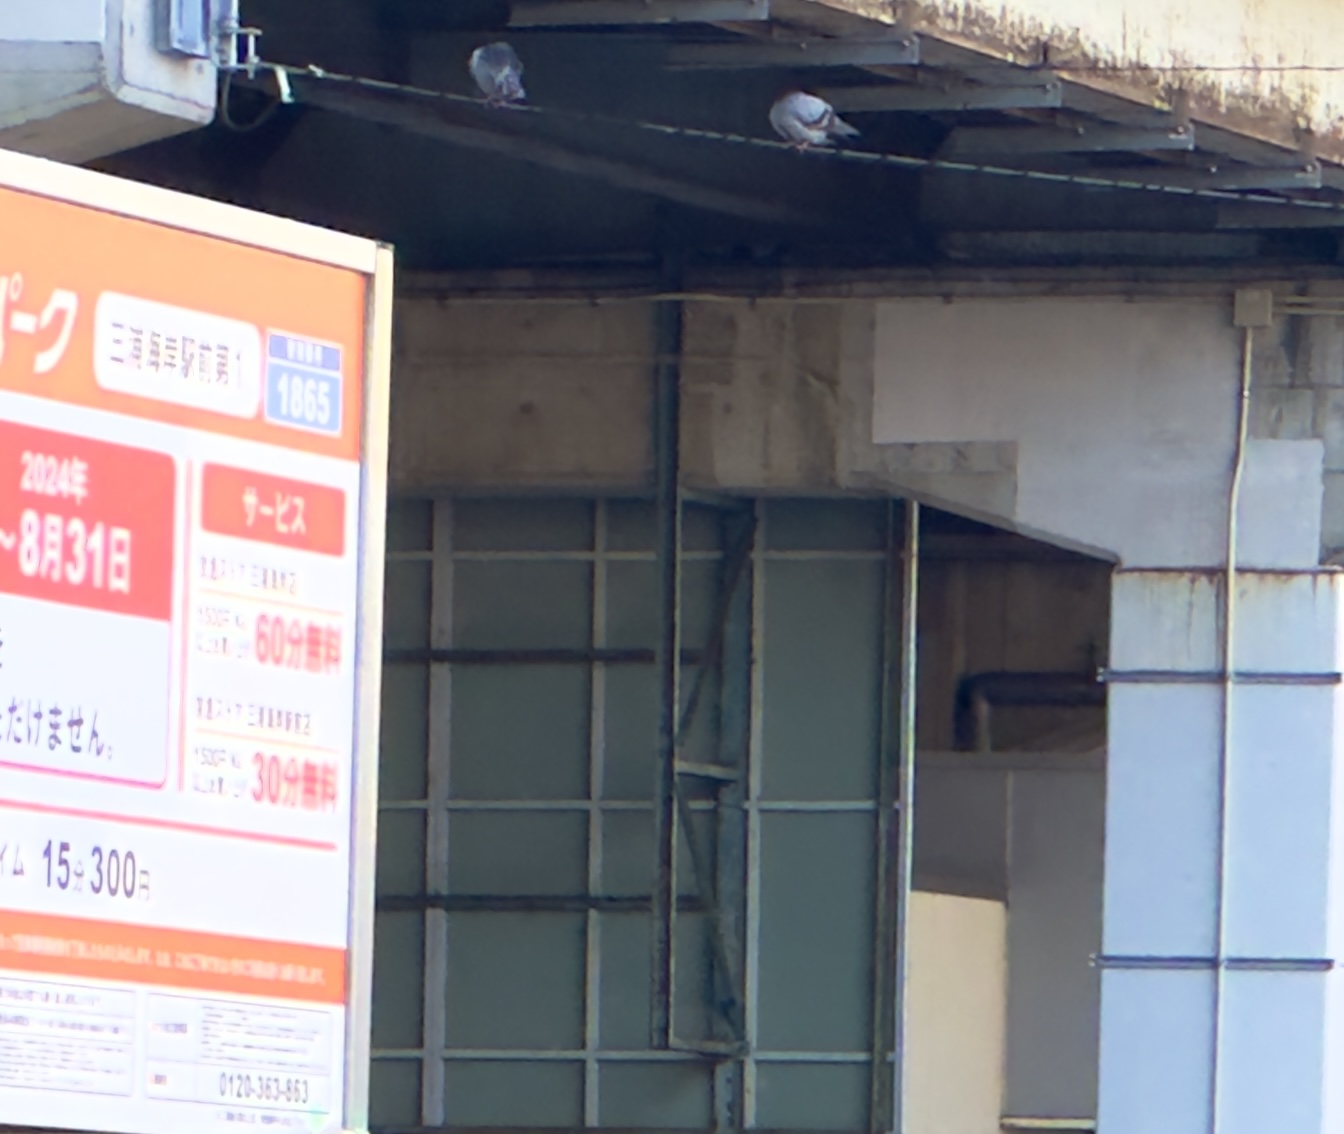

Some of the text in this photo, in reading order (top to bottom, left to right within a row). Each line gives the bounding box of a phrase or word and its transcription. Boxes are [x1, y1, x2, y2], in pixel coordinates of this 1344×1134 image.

[277, 372, 331, 425] 1865
[19, 450, 88, 504] 2024年
[243, 486, 307, 535] サービス
[255, 611, 342, 674] 60分無料
[0, 697, 112, 760] だけません。
[251, 752, 338, 813] 30分無料
